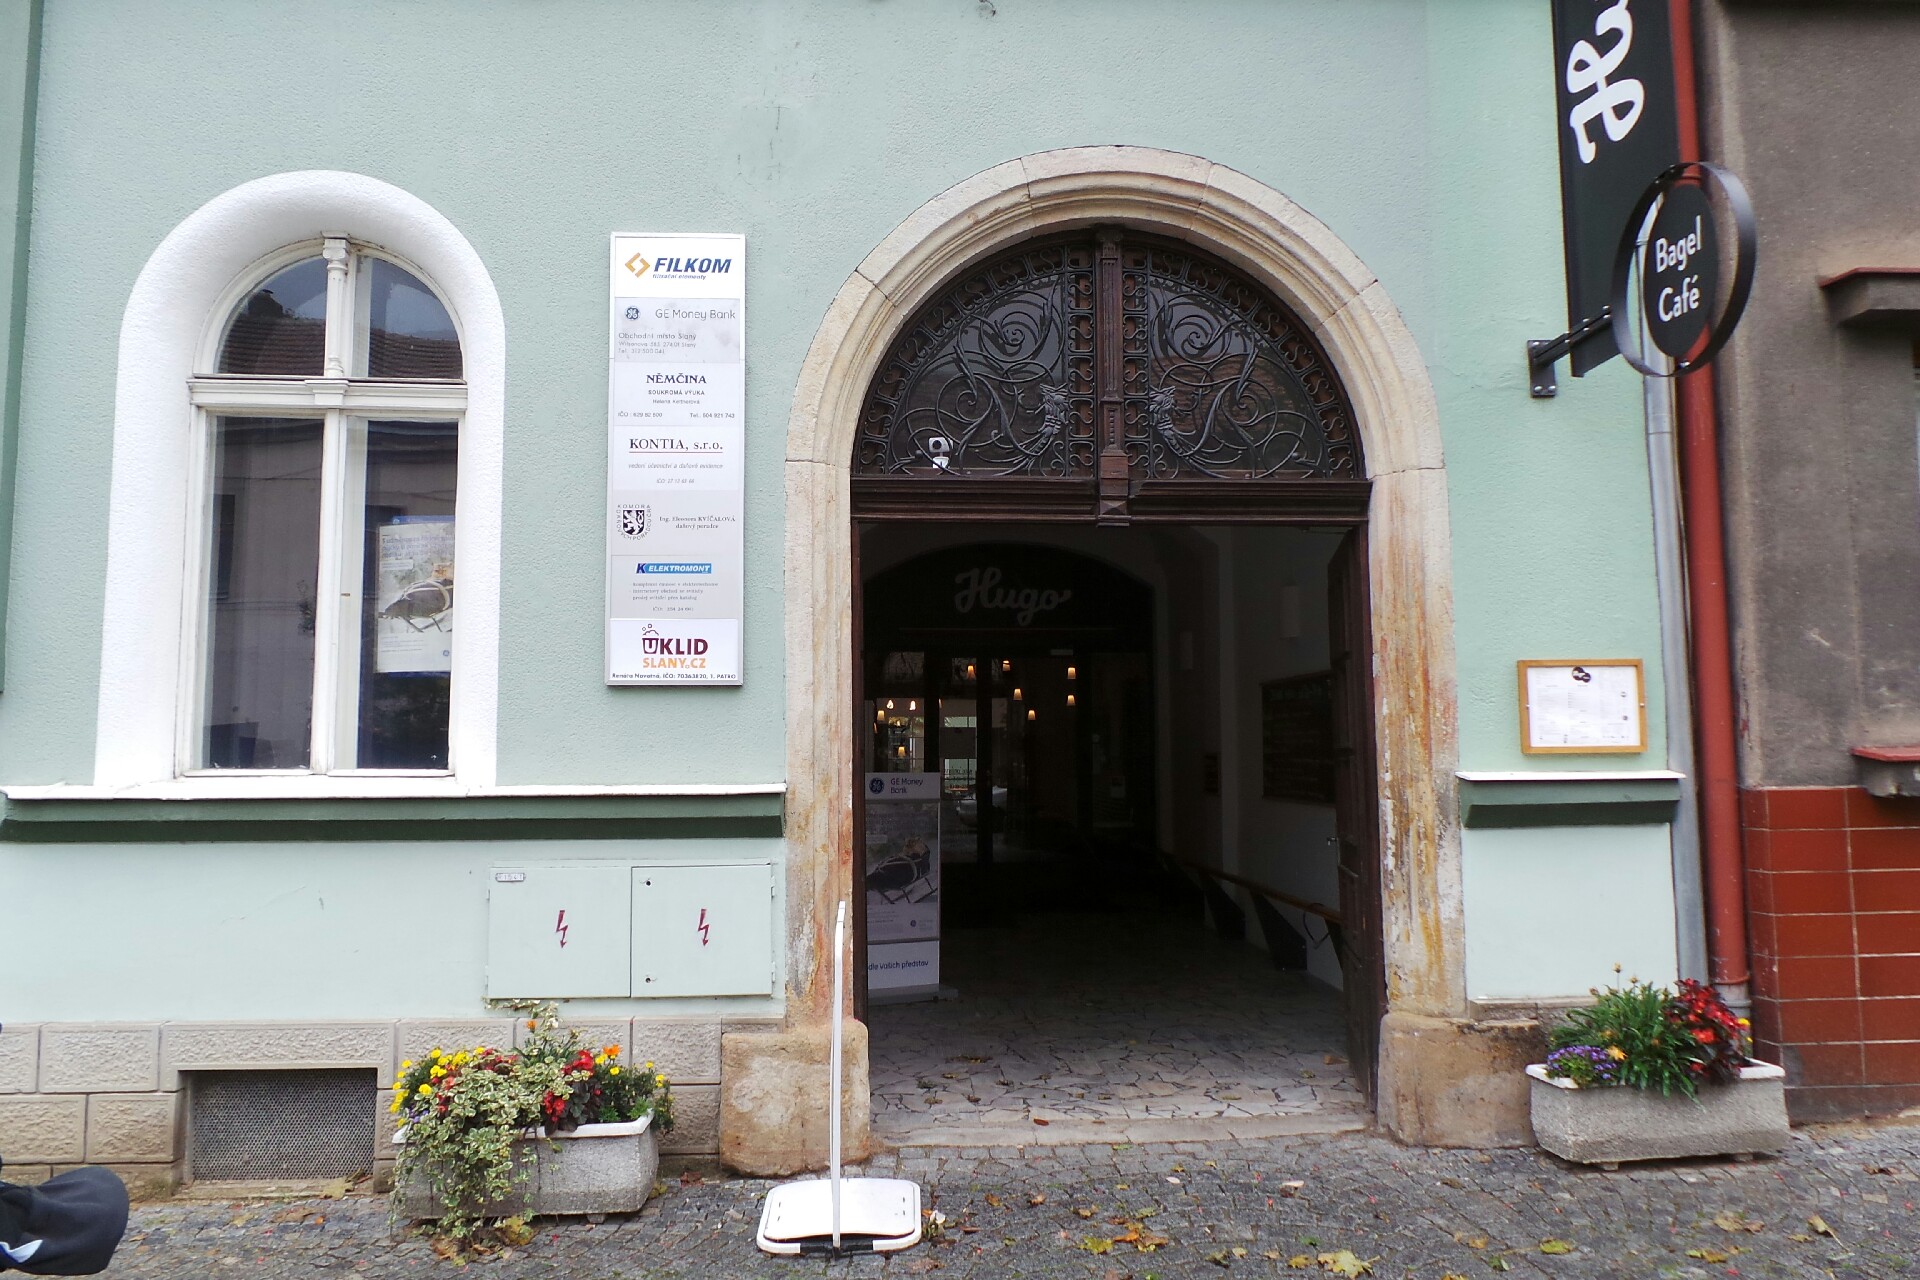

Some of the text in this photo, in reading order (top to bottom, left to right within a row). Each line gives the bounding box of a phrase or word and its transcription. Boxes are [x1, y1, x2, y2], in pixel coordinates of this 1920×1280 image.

[1656, 215, 1701, 273] Bagel
[654, 258, 732, 273] FILKOM
[1658, 275, 1700, 322] Café
[655, 309, 736, 321] GE Money Bank
[646, 373, 707, 384] NĚMČINA
[629, 438, 723, 451] KONTIA, s.r.o.
[954, 567, 1072, 626] Hugo
[643, 657, 707, 669] SLANY.CZ
[890, 778, 924, 787] GE Money
[901, 960, 929, 969] představ
